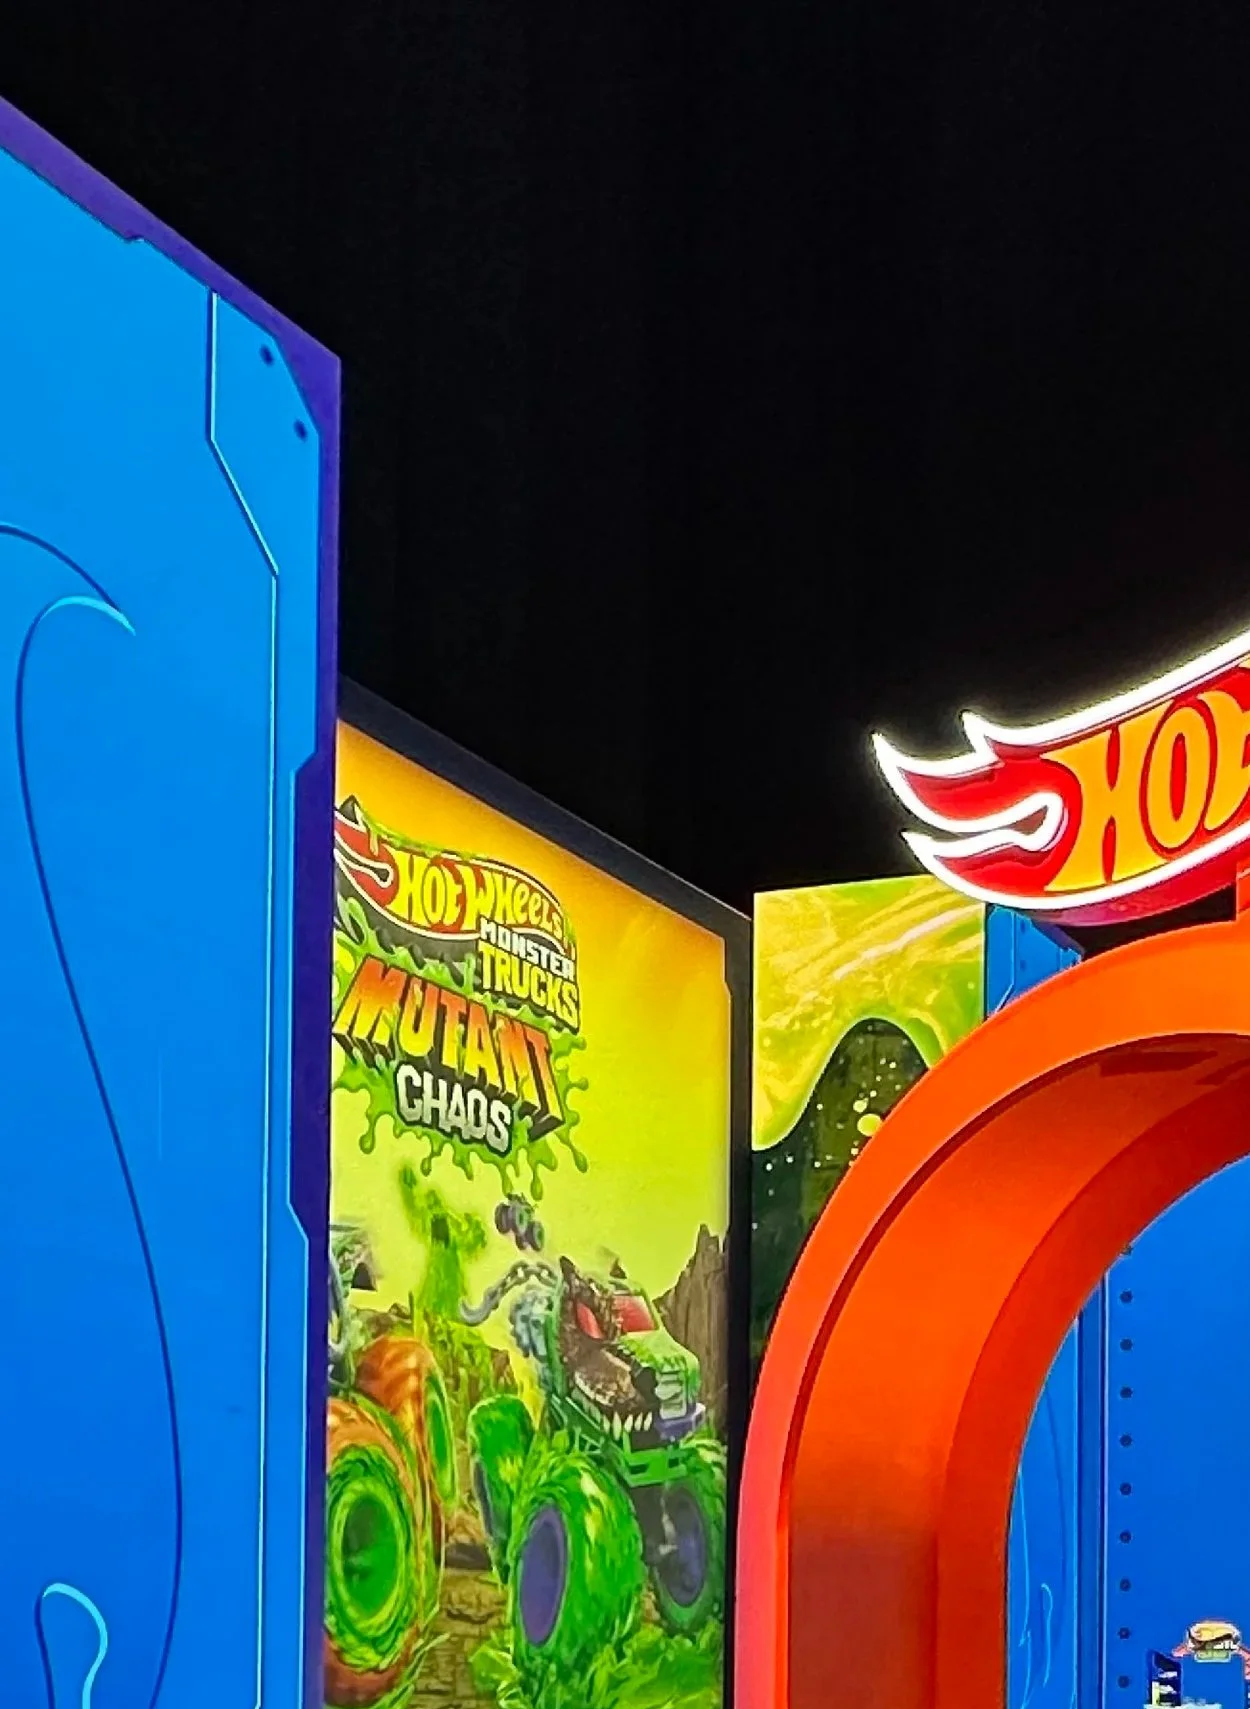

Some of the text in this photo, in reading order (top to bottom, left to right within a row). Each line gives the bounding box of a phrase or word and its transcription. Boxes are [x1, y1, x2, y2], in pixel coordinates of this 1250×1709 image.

[479, 943, 578, 1028] TRUCKS
[480, 916, 575, 979] MONSTER
[333, 955, 566, 1123] MUTANT
[396, 1063, 512, 1153] CHAOS
